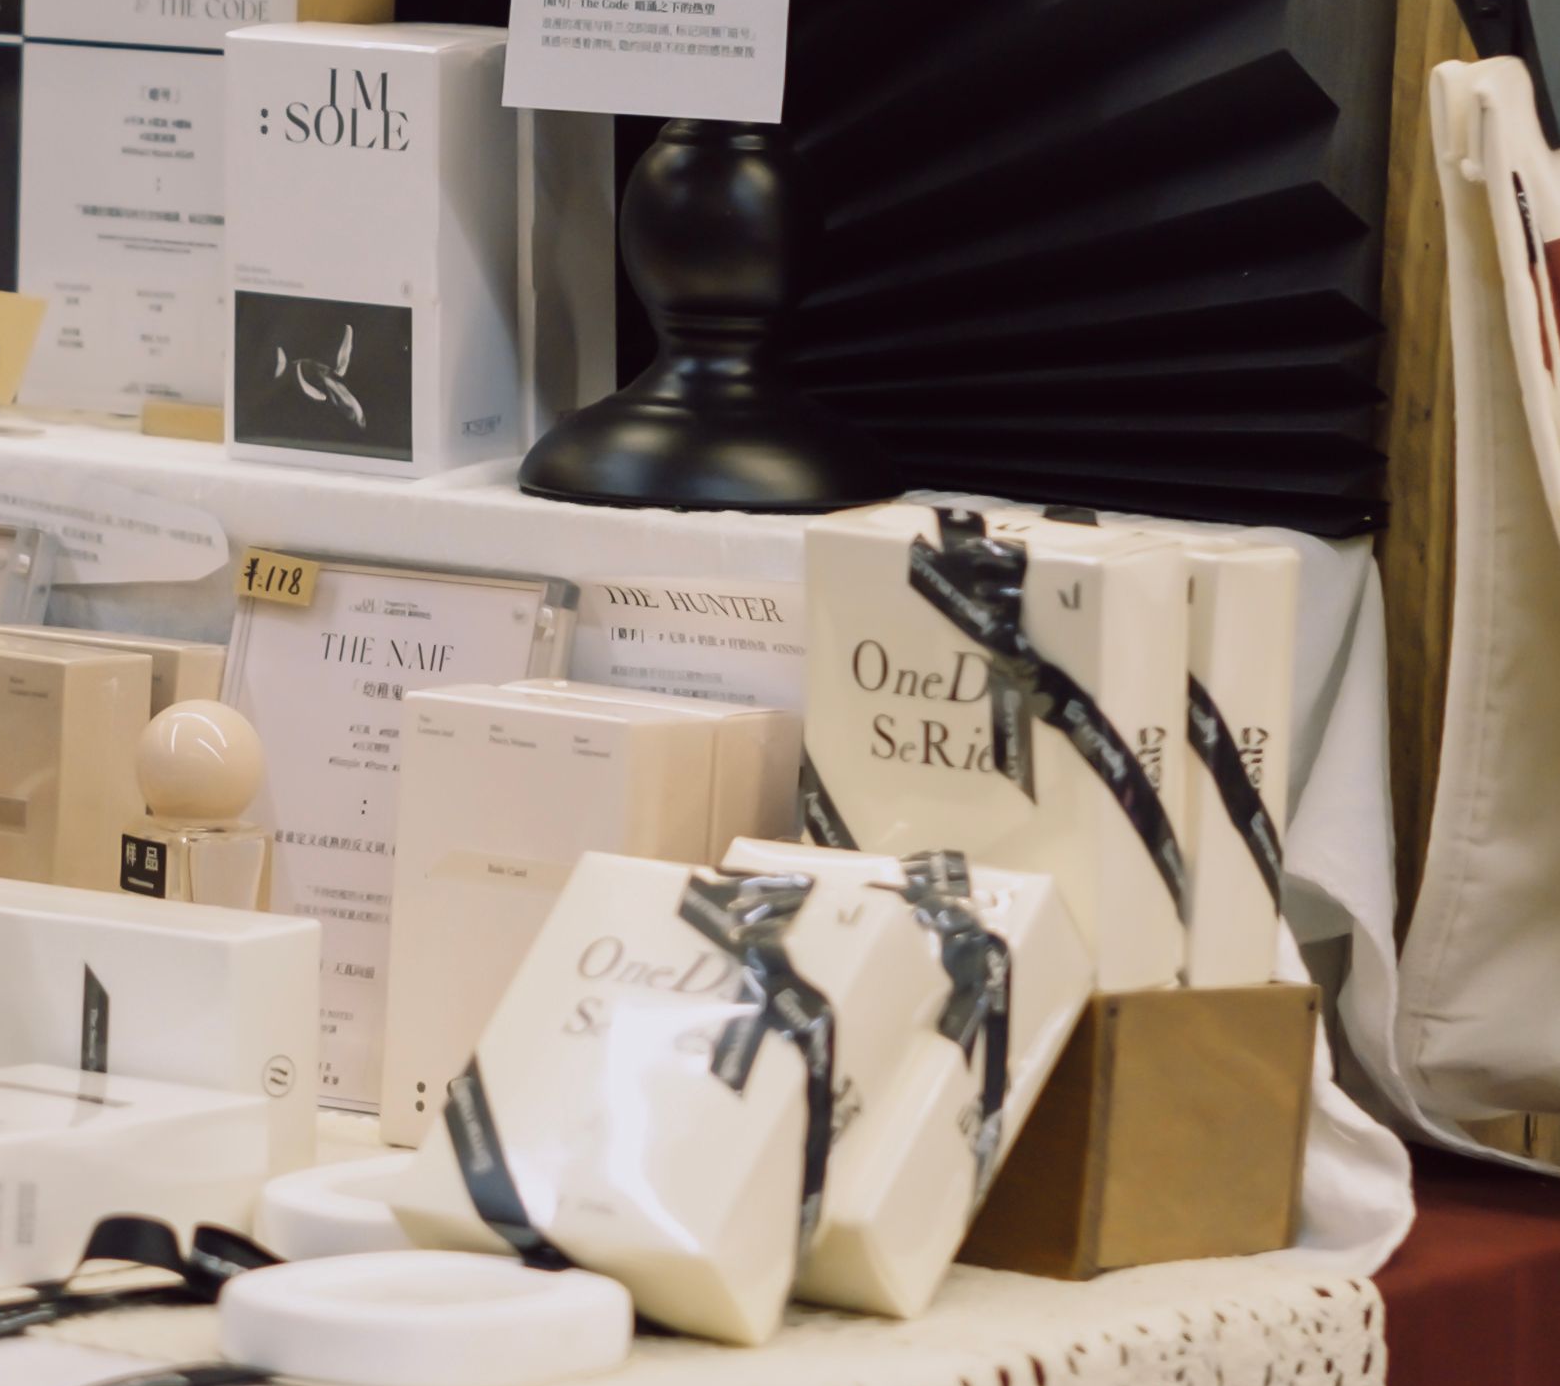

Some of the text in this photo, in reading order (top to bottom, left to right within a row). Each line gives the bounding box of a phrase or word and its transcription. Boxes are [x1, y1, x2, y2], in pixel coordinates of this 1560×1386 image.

[328, 67, 390, 113] IM
[596, 584, 784, 623] THE HUNTER
[321, 631, 454, 673] THE NAIF
[852, 637, 990, 704] OneD
[871, 713, 995, 773] SeRie
[126, 842, 159, 871] 样品
